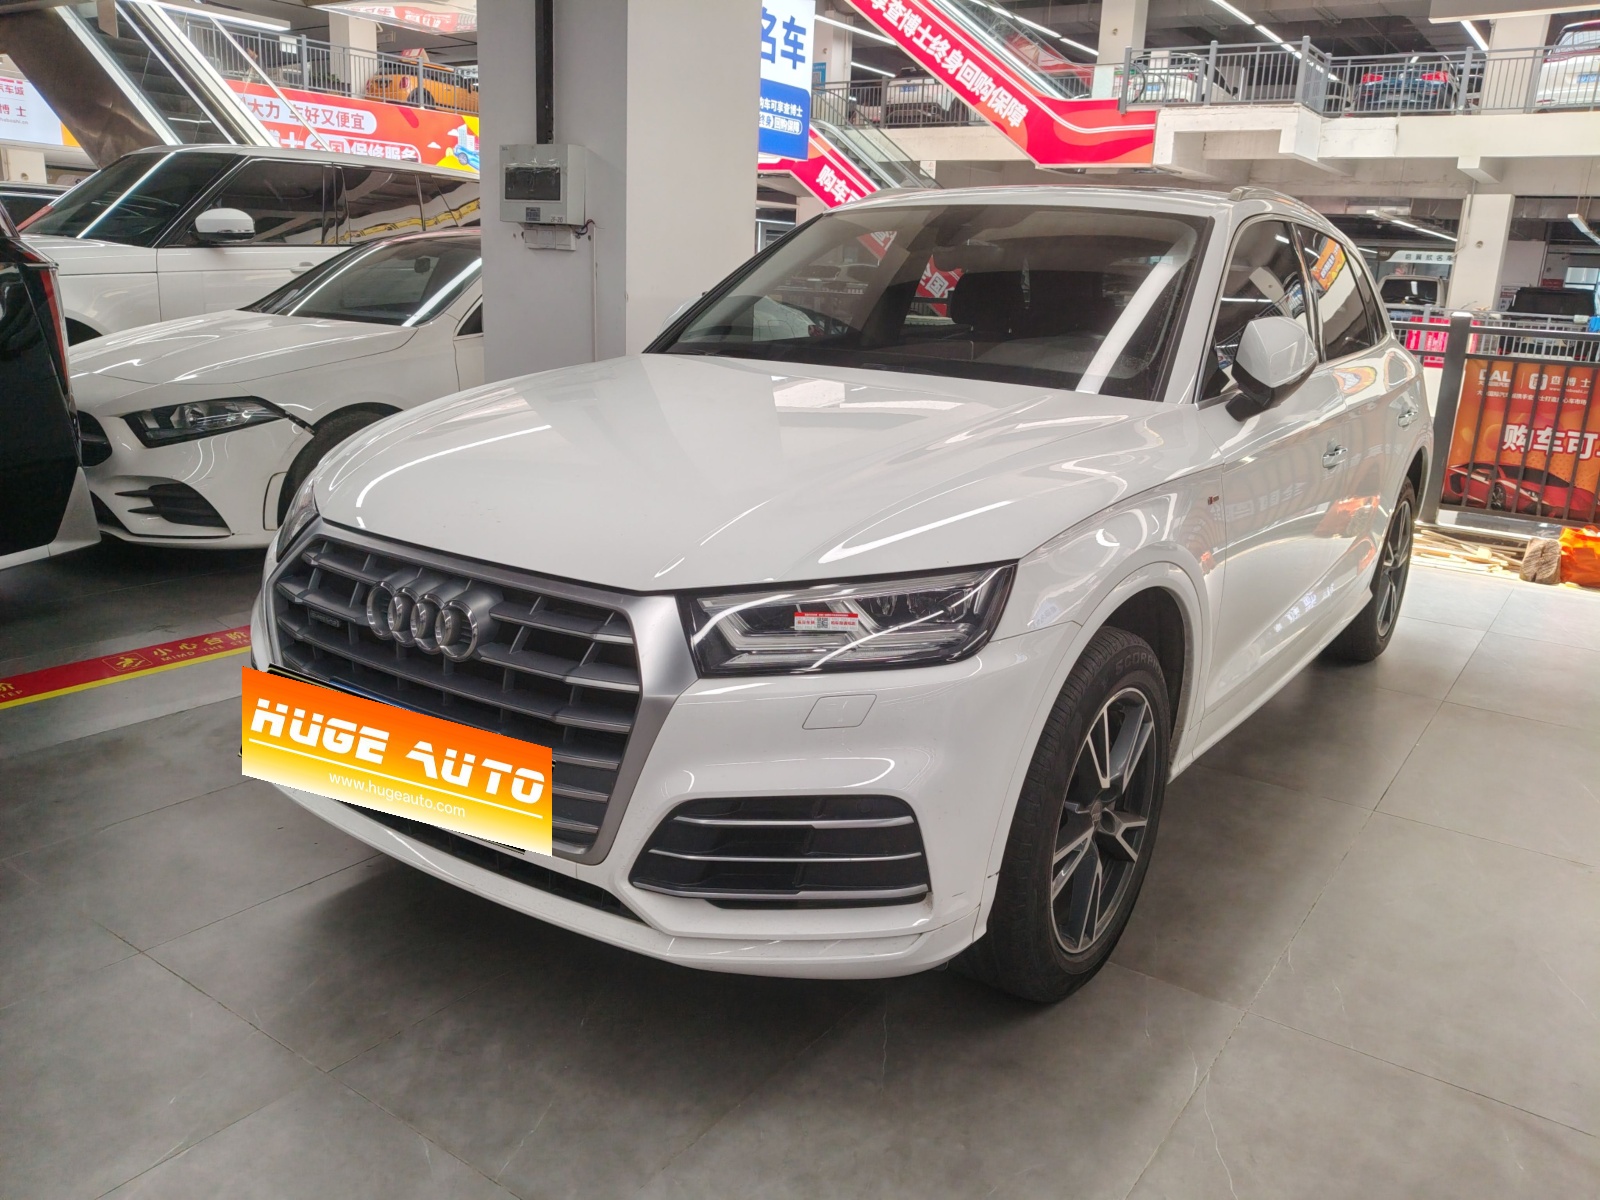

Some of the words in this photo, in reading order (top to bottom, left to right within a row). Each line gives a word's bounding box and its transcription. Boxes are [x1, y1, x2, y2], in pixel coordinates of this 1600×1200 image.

[241, 96, 280, 120] 大力
[289, 104, 365, 131] 车好又便宜
[153, 631, 247, 656] 小心台阶
